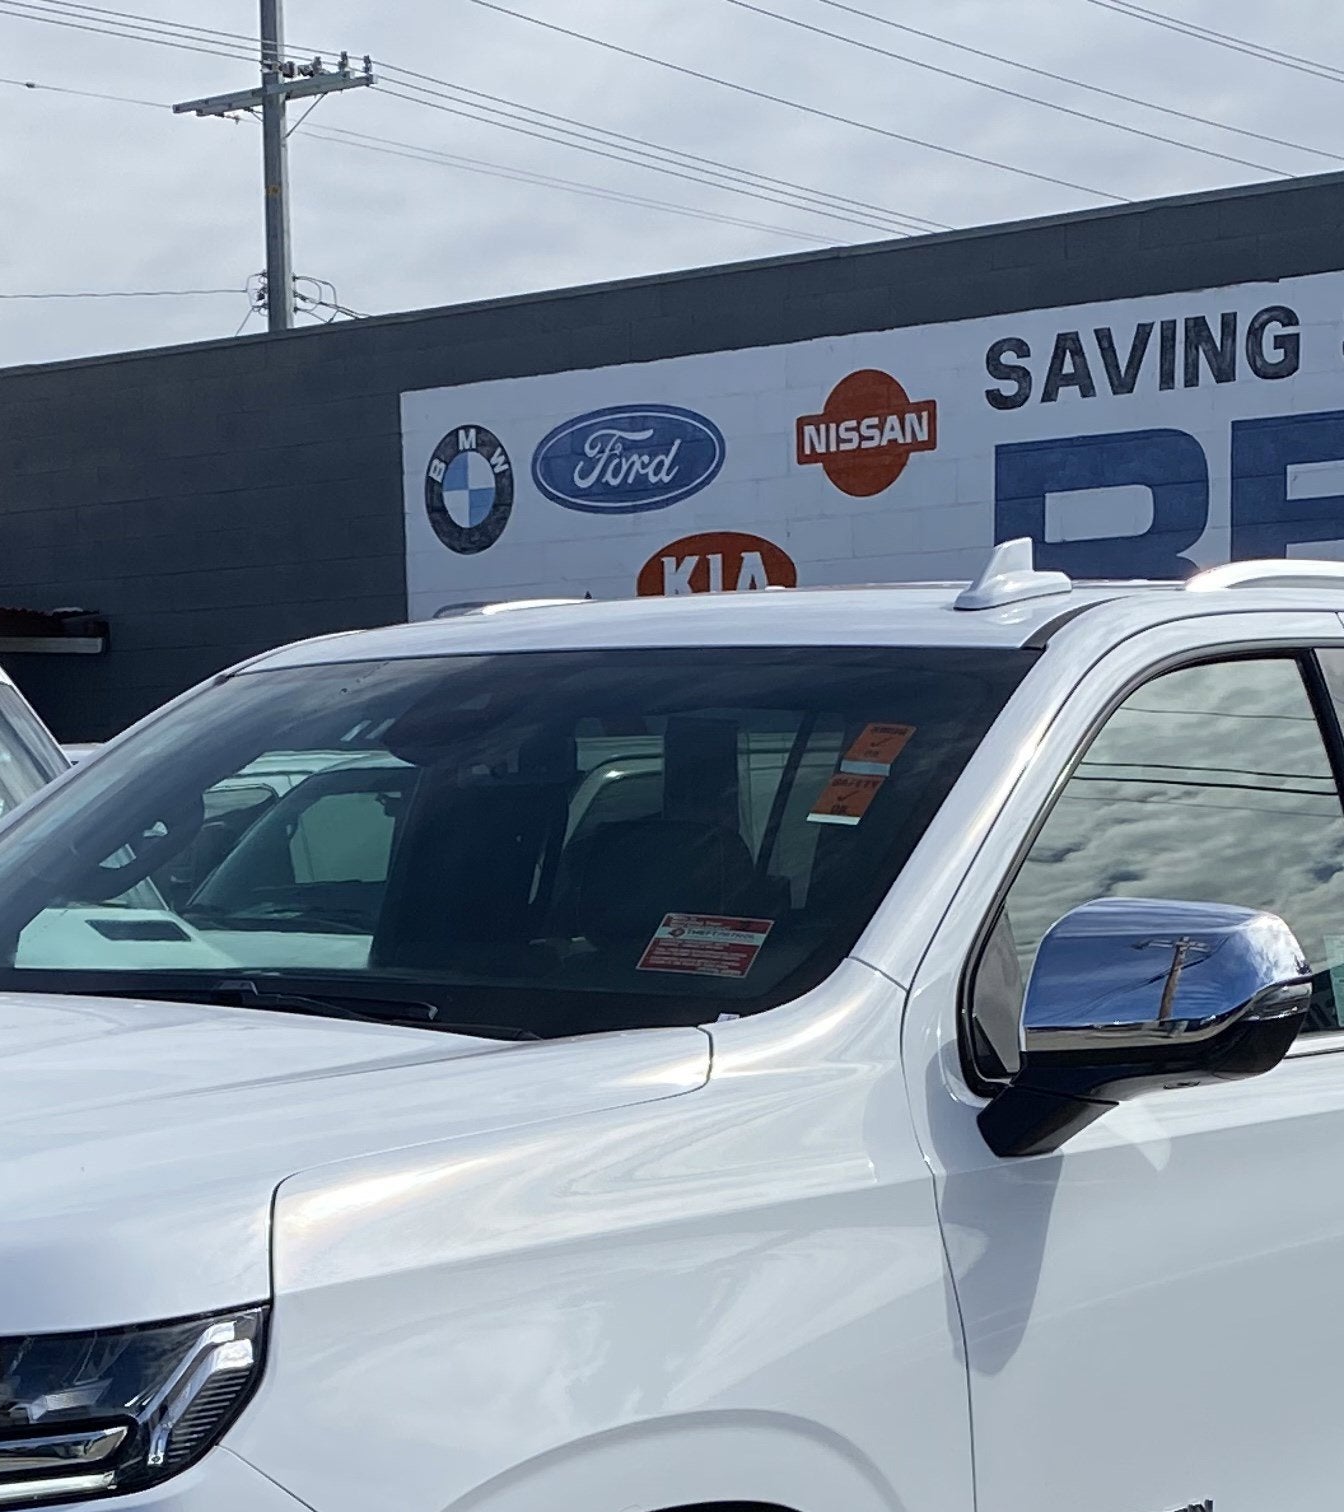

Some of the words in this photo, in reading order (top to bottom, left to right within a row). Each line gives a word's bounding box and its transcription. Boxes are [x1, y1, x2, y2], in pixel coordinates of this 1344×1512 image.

[984, 304, 1301, 411] SAVING
[427, 427, 511, 485] BMW
[573, 427, 683, 490] Ford
[802, 410, 930, 456] NISSAN
[659, 550, 770, 596] KIA
